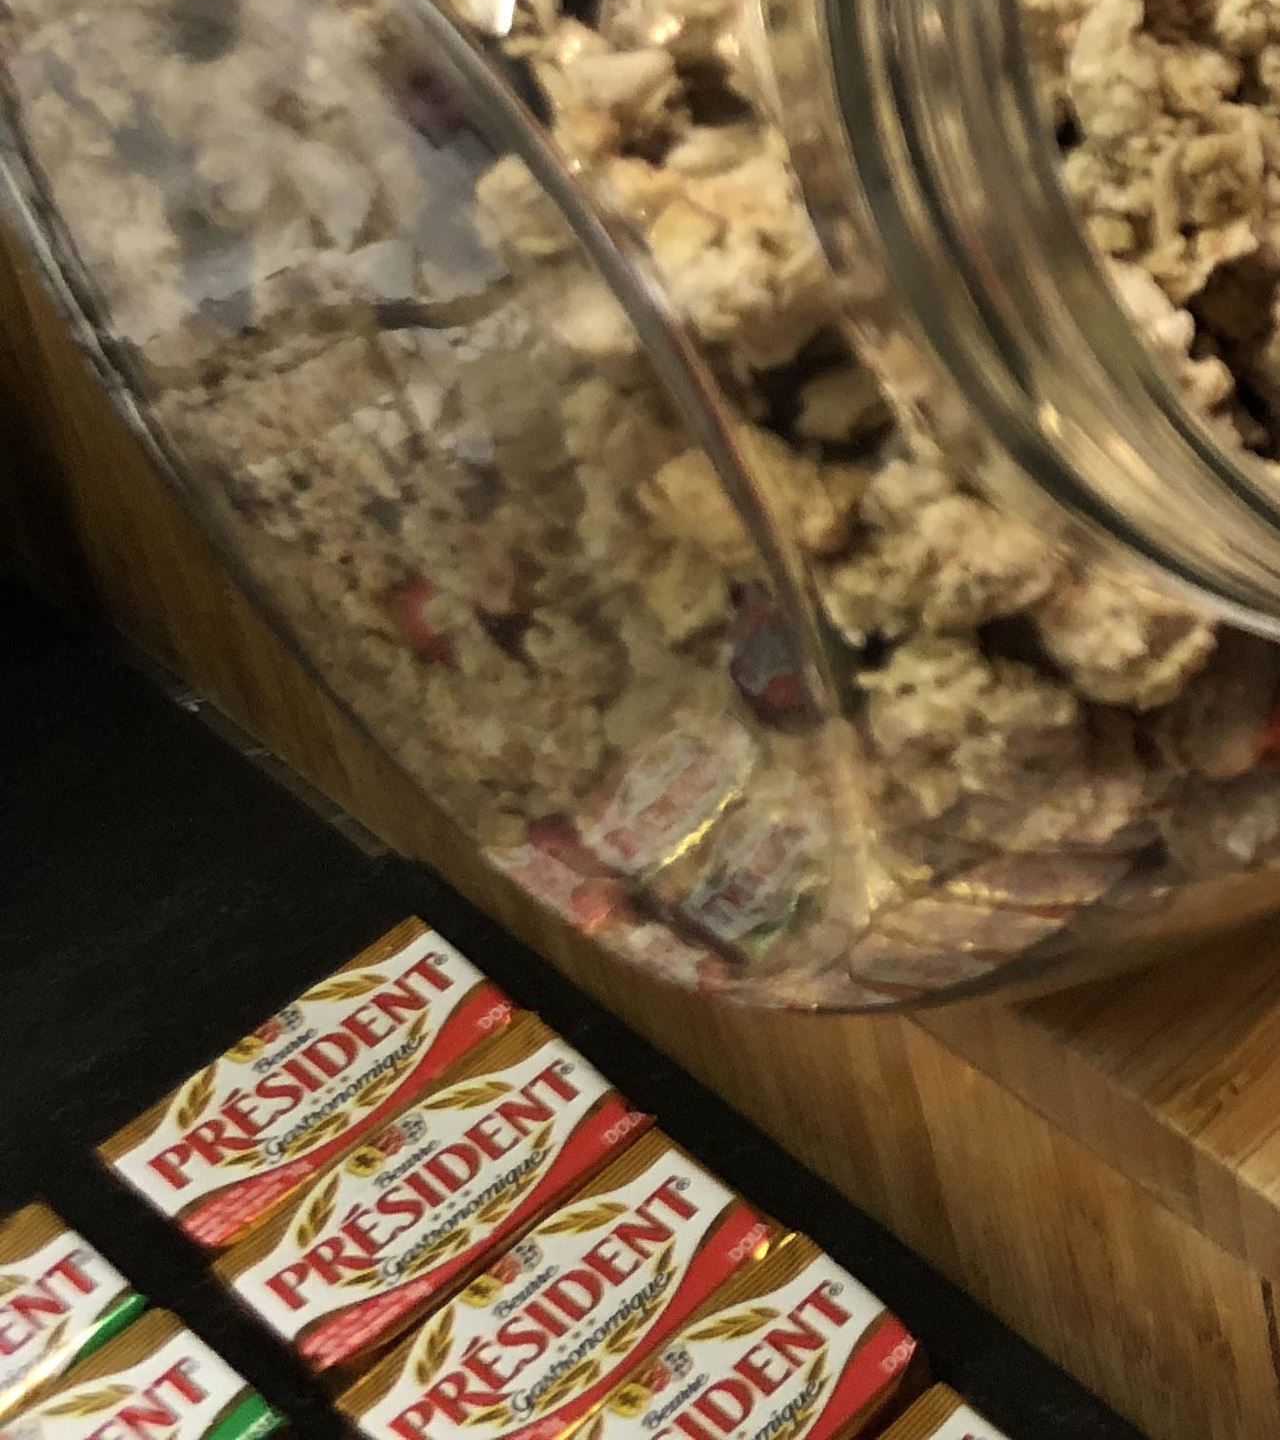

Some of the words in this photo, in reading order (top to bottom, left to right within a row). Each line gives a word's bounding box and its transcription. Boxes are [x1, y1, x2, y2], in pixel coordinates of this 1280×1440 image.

[147, 951, 455, 1190] PRÉSIDENT
[252, 1028, 318, 1073] Beurre
[264, 1028, 430, 1167] Gastronomique
[266, 1059, 580, 1310] PRÉSIDENT
[375, 1138, 441, 1189] Beurre
[379, 1146, 551, 1287] Gastronomique
[492, 1264, 559, 1318] Beurre
[511, 1270, 670, 1423] Gastronomique
[642, 1373, 709, 1429] Beurre
